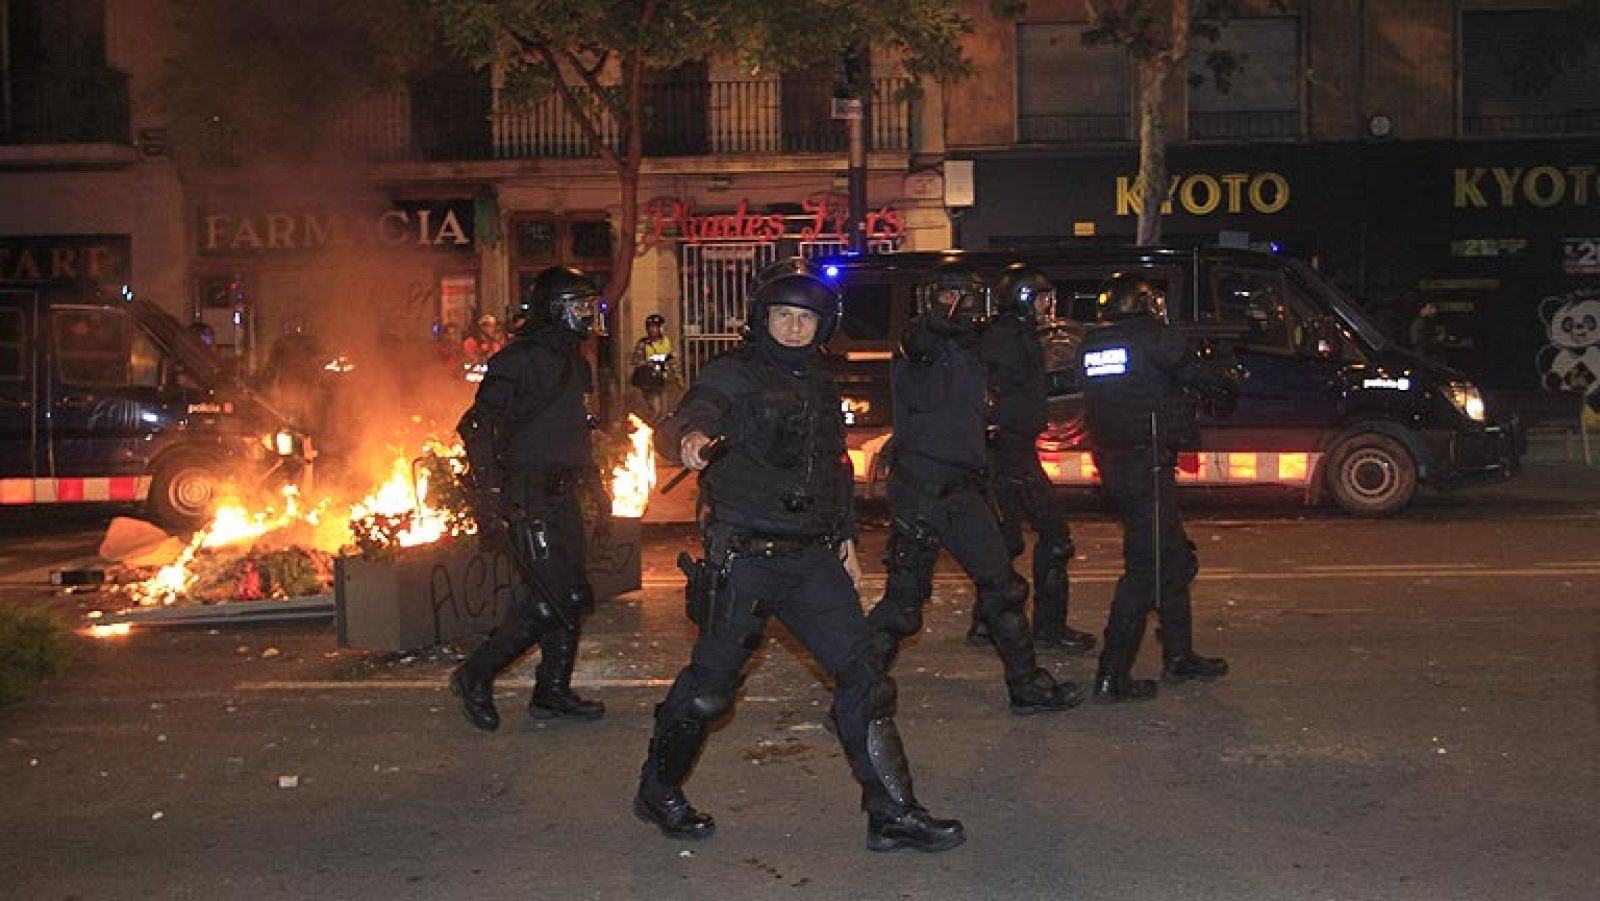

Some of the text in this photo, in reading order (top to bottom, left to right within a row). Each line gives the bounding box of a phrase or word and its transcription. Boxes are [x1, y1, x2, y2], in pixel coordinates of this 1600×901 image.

[1115, 172, 1291, 215] KYOTO
[1453, 166, 1600, 208] KYOT
[206, 208, 470, 250] FARMCIA
[801, 192, 906, 245] Flrs
